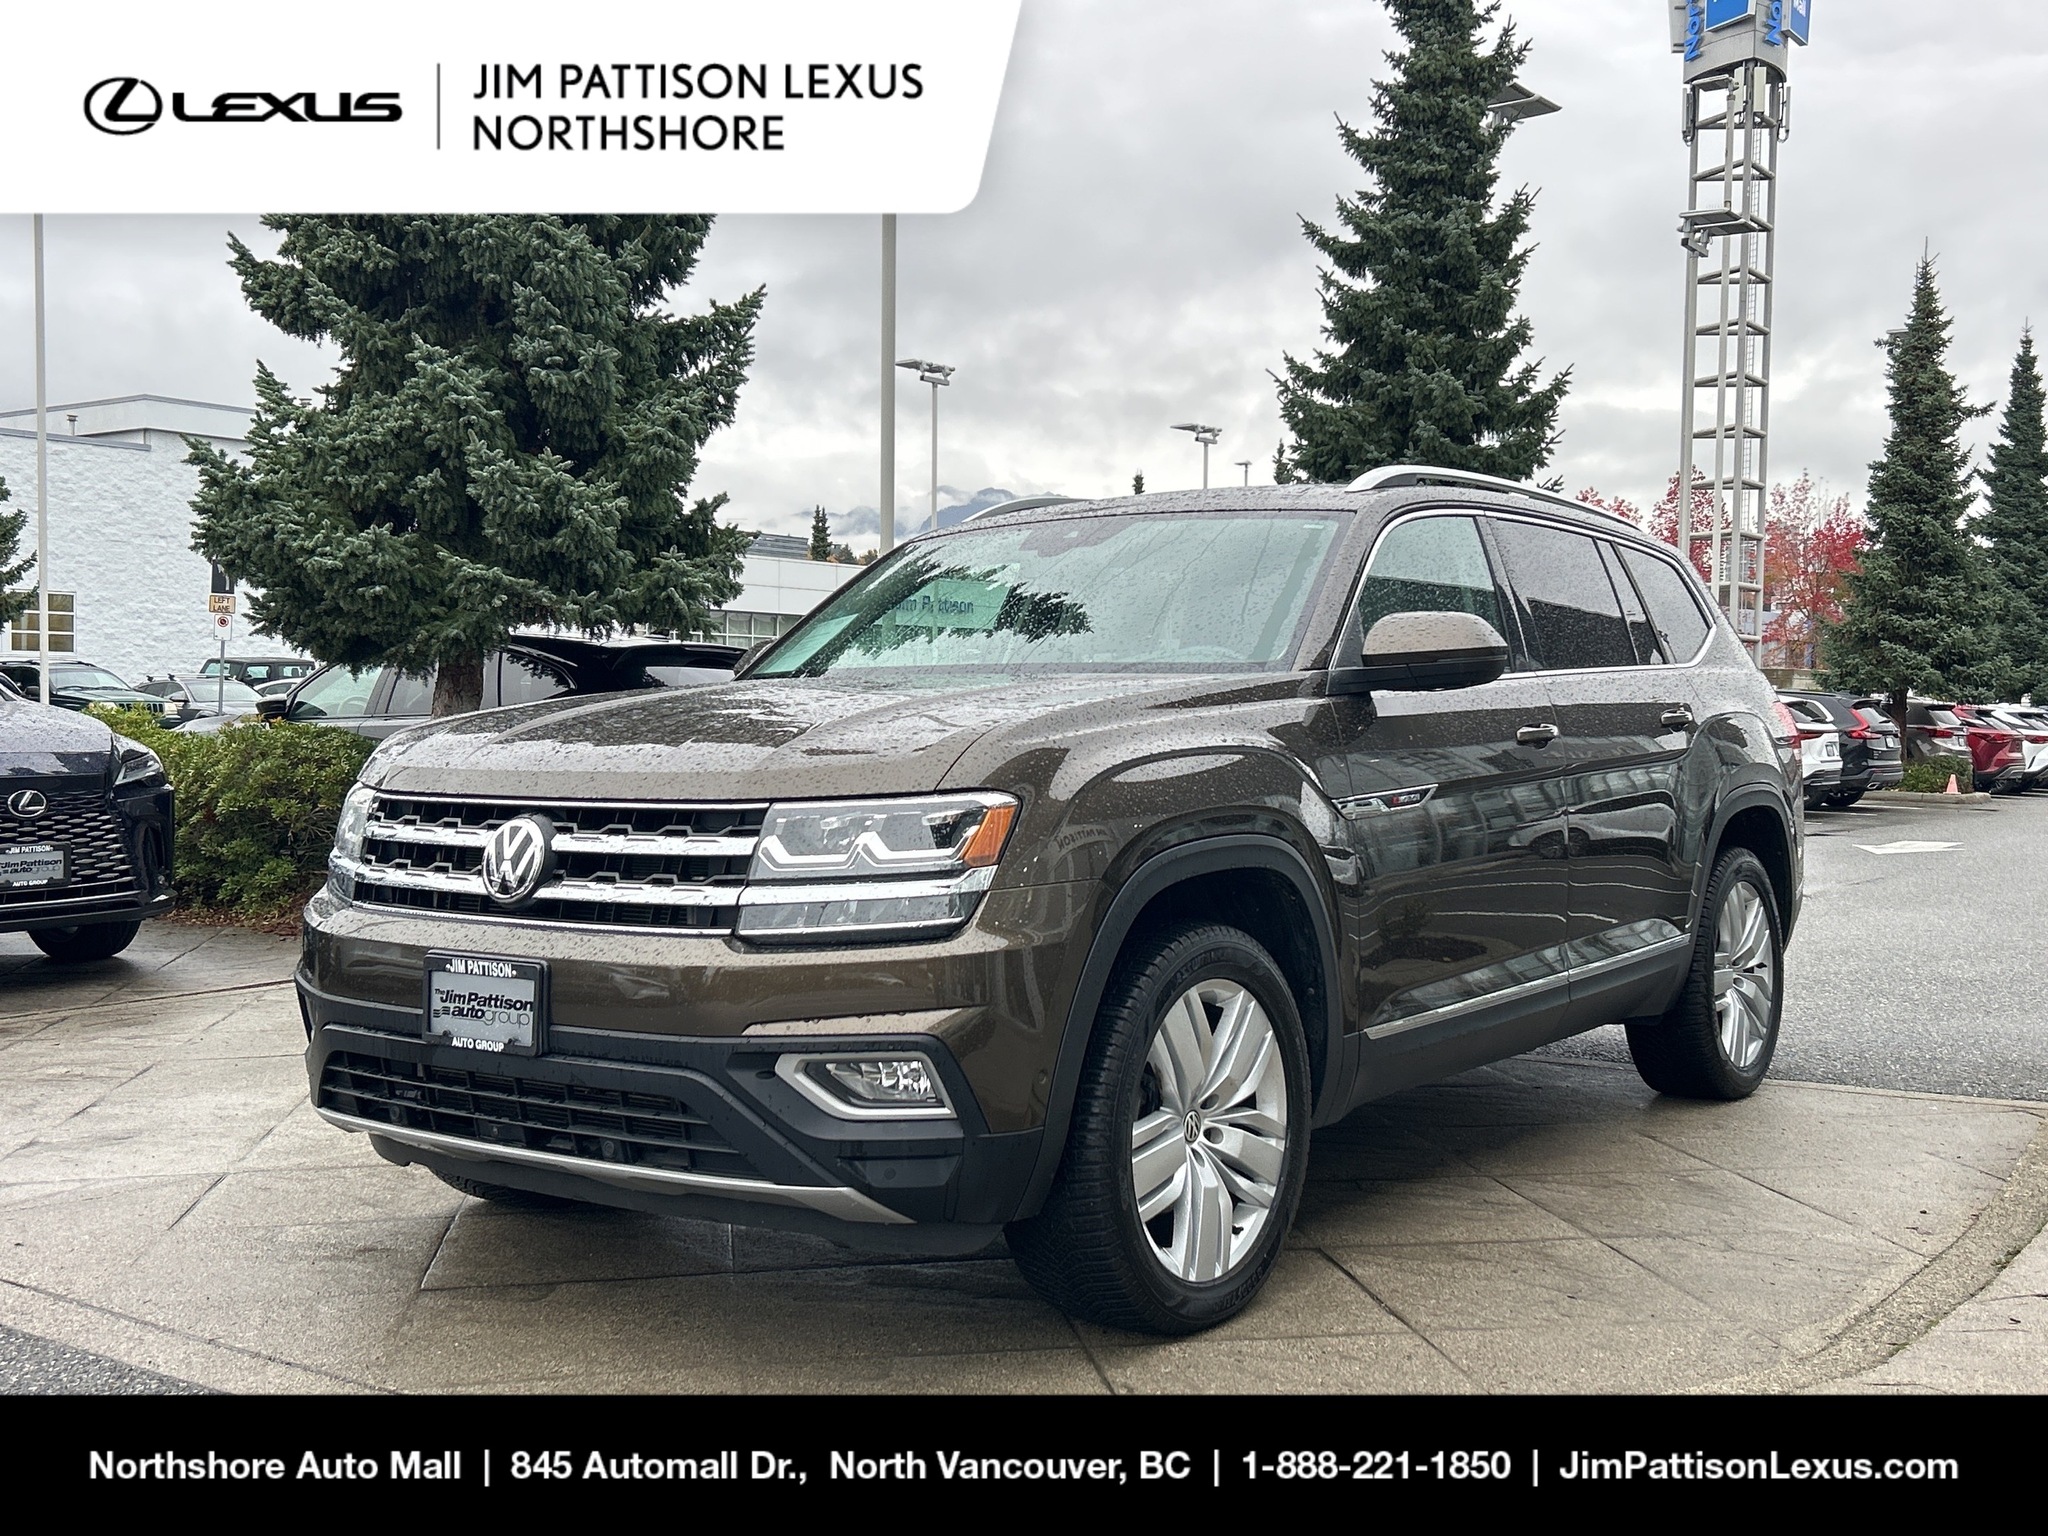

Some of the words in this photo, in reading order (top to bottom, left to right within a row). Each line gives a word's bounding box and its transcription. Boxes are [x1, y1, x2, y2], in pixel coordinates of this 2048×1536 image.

[213, 605, 231, 613] LANE
[10, 846, 20, 854] JIM
[21, 845, 51, 853] PATTISON
[450, 959, 466, 974] JIM
[467, 960, 512, 978] PATTISON
[434, 988, 446, 996] The
[451, 1036, 475, 1049] AUTO
[475, 1039, 505, 1053] GROUP
